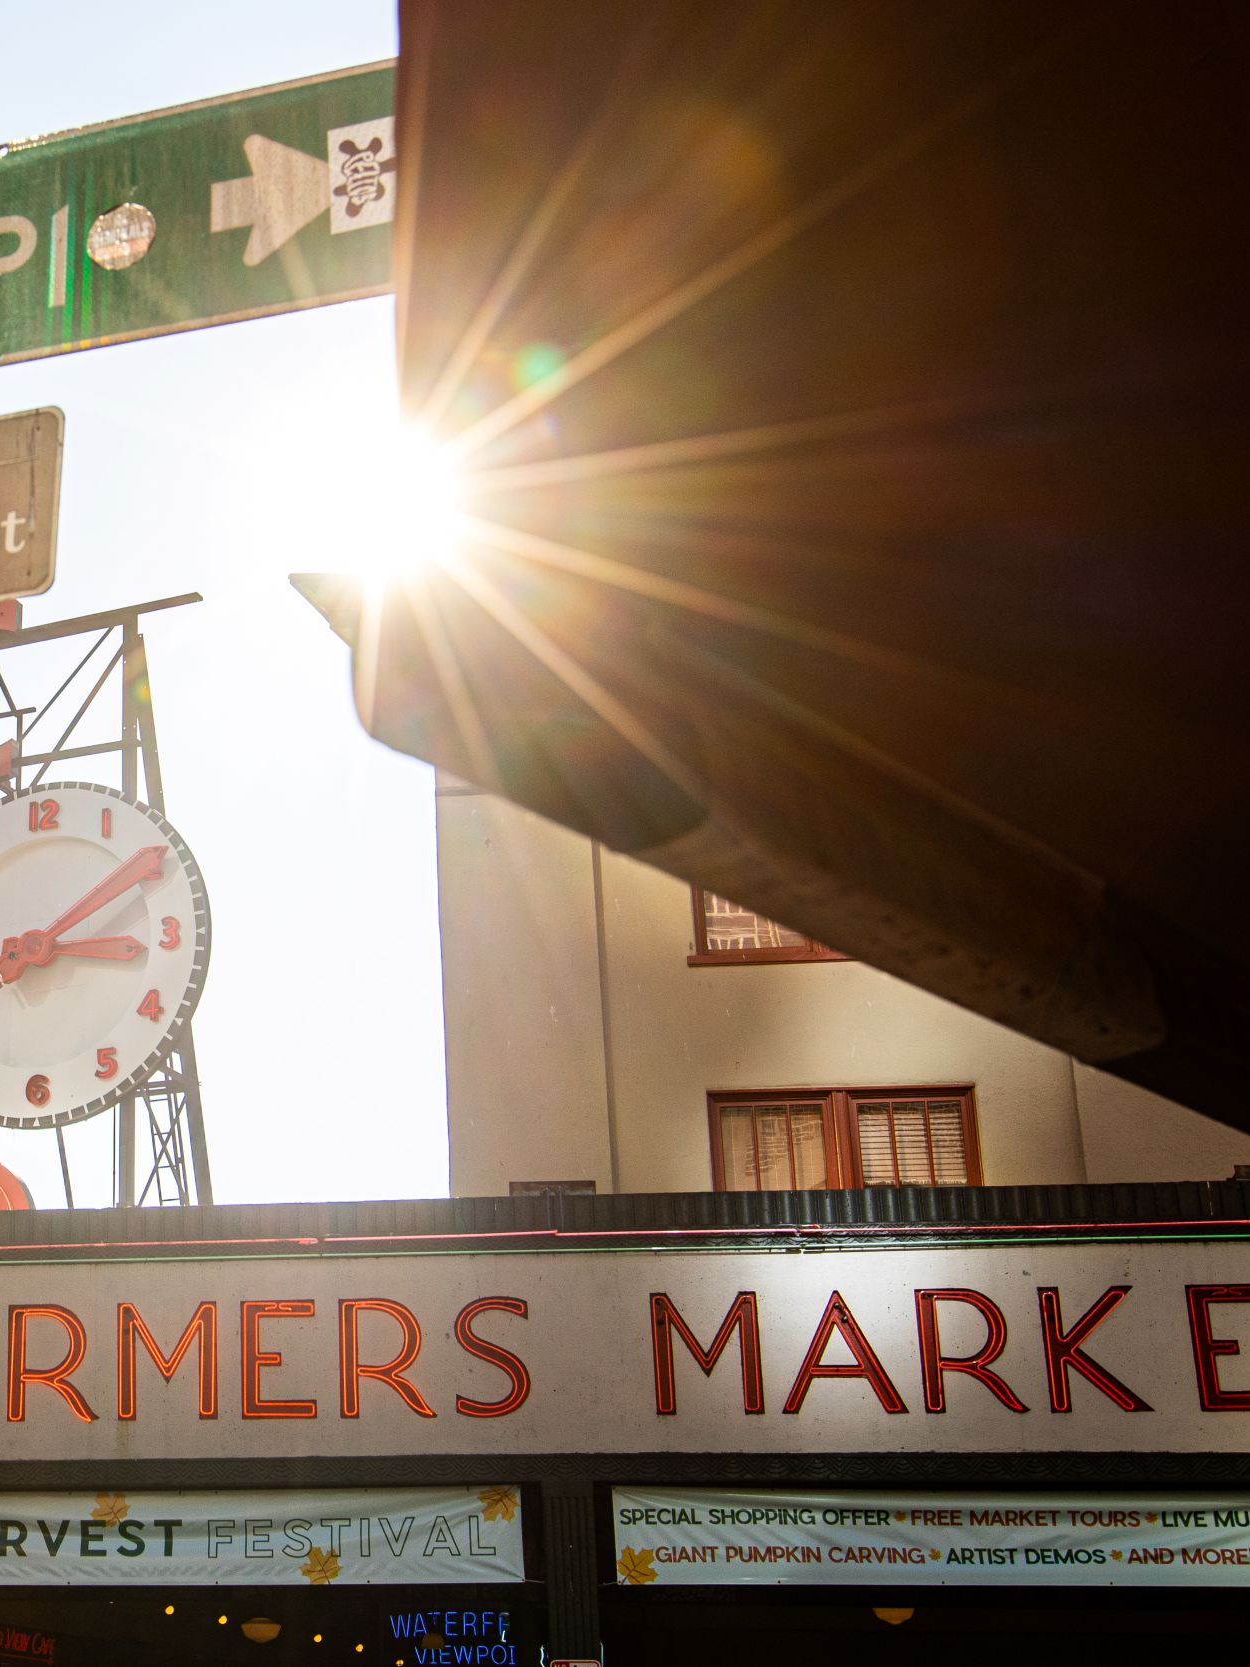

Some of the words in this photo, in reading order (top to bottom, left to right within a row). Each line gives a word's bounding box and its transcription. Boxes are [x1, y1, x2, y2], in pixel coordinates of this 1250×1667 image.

[29, 798, 61, 833] 12
[101, 807, 112, 839] 1
[158, 916, 181, 950] 3
[137, 988, 165, 1023] 4
[94, 1046, 119, 1081] 5
[25, 1074, 52, 1108] 6
[650, 1284, 1250, 1416] MARKE
[619, 1508, 702, 1526] SPECIAL
[708, 1508, 817, 1526] SHOPPING
[822, 1509, 891, 1527] OFFER
[911, 1509, 963, 1527] FREE
[969, 1510, 1061, 1527] MARKET
[1067, 1510, 1141, 1528] TOURS
[1161, 1510, 1208, 1528] LIVE
[207, 1515, 497, 1559] FESTIVAL
[654, 1546, 719, 1563] GIANT
[725, 1546, 822, 1564] PUMPKIN
[828, 1546, 926, 1565] CARVING
[946, 1547, 1018, 1565] ARTIST
[1024, 1547, 1107, 1566] DEMOS
[1127, 1547, 1175, 1566] AND
[1180, 1547, 1250, 1566] MORE
